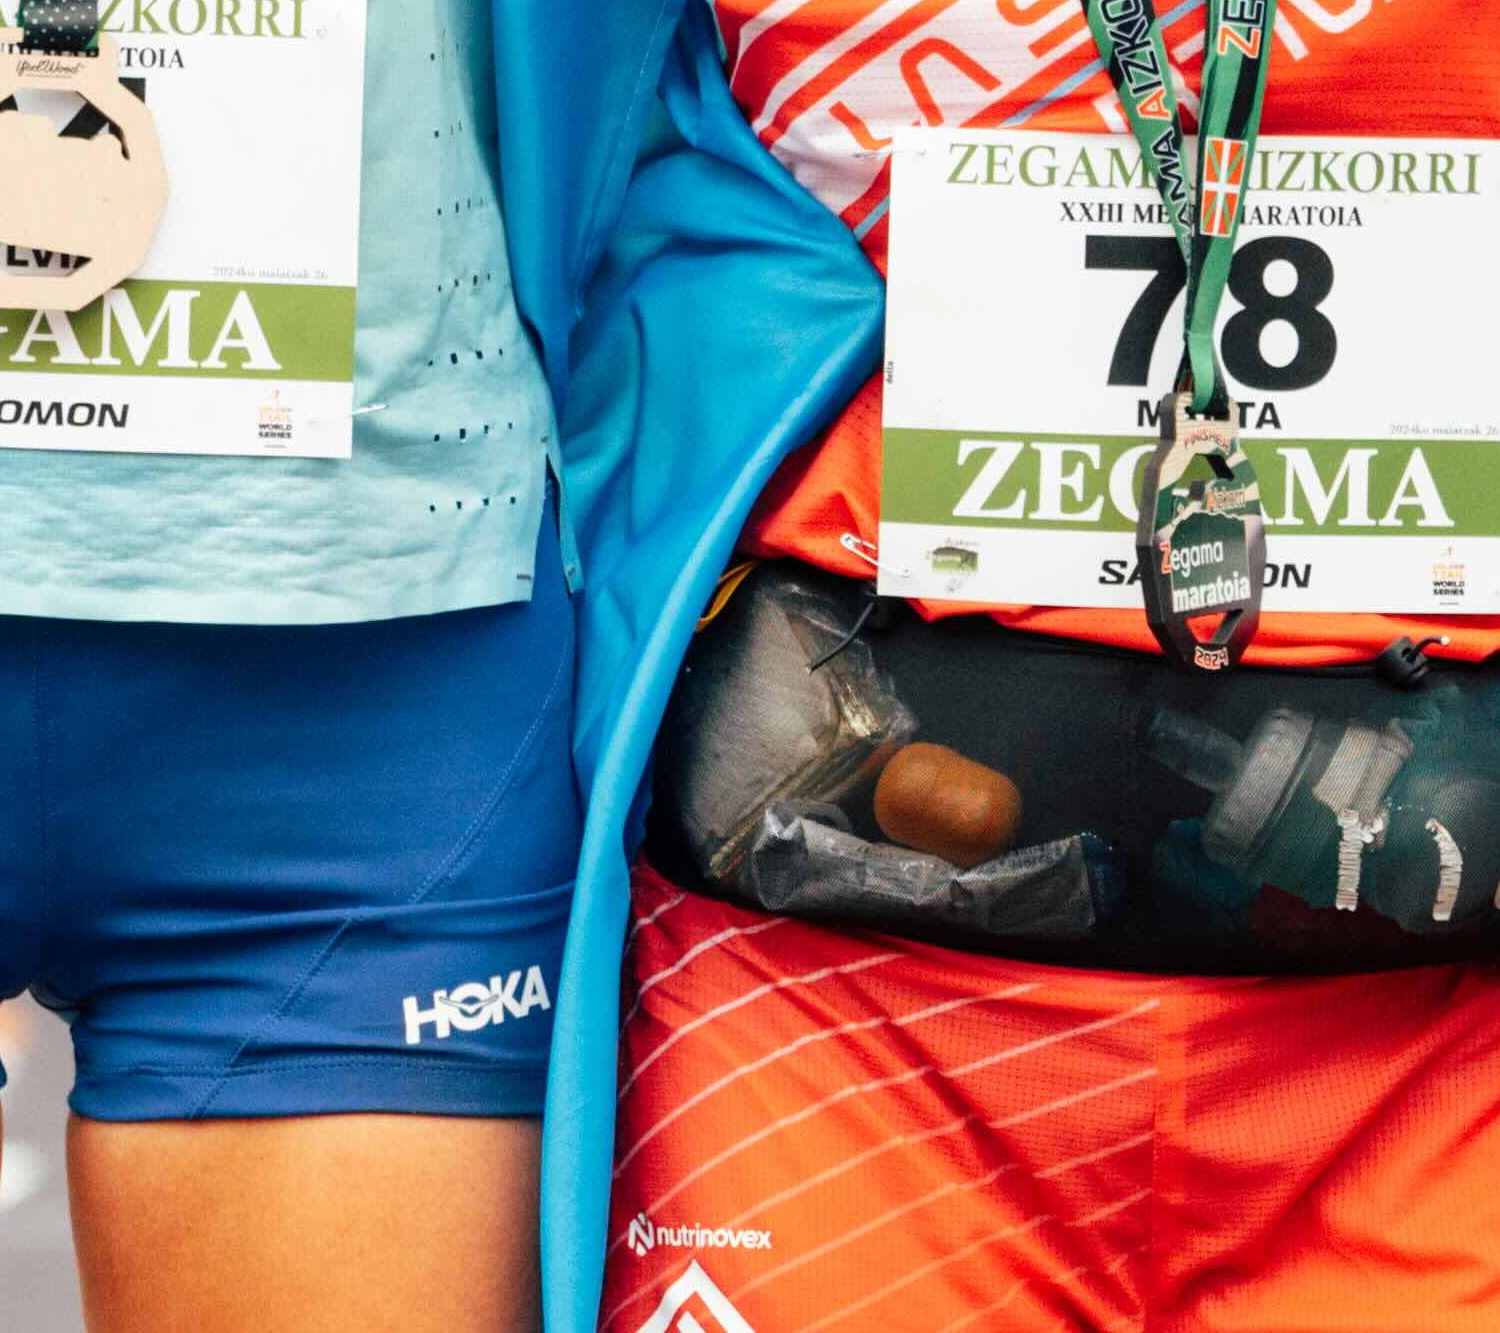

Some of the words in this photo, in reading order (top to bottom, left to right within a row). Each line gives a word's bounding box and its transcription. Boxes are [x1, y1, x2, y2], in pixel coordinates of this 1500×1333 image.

[1257, 149, 1483, 196] IZKORRI
[1084, 234, 1339, 392] 78
[1160, 540, 1224, 578] Zegama
[1172, 570, 1251, 614] maratoia
[1193, 645, 1230, 671] 2024
[402, 964, 552, 1046] HOKA
[657, 1223, 772, 1250] nutrinovex
